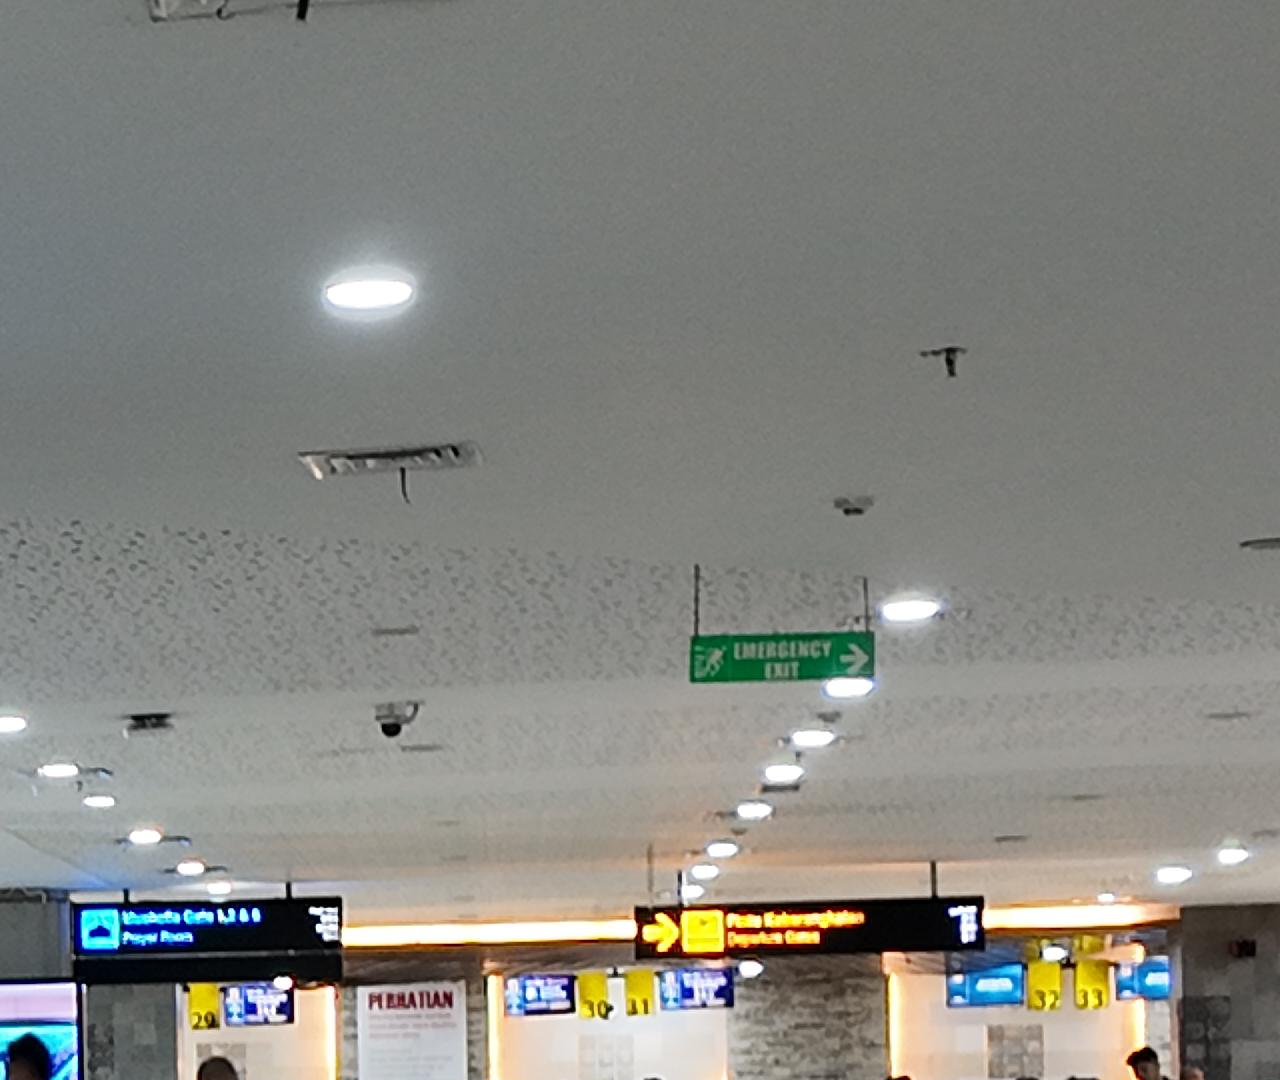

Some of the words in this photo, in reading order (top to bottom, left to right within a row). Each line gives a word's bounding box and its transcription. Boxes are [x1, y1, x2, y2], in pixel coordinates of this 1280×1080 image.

[734, 640, 831, 659] EMERGENCY
[765, 662, 798, 681] EXIT
[368, 991, 454, 1010] PERHATIAN
[1037, 990, 1058, 1009] 32
[1081, 989, 1103, 1008] 33
[191, 1011, 217, 1029] 29
